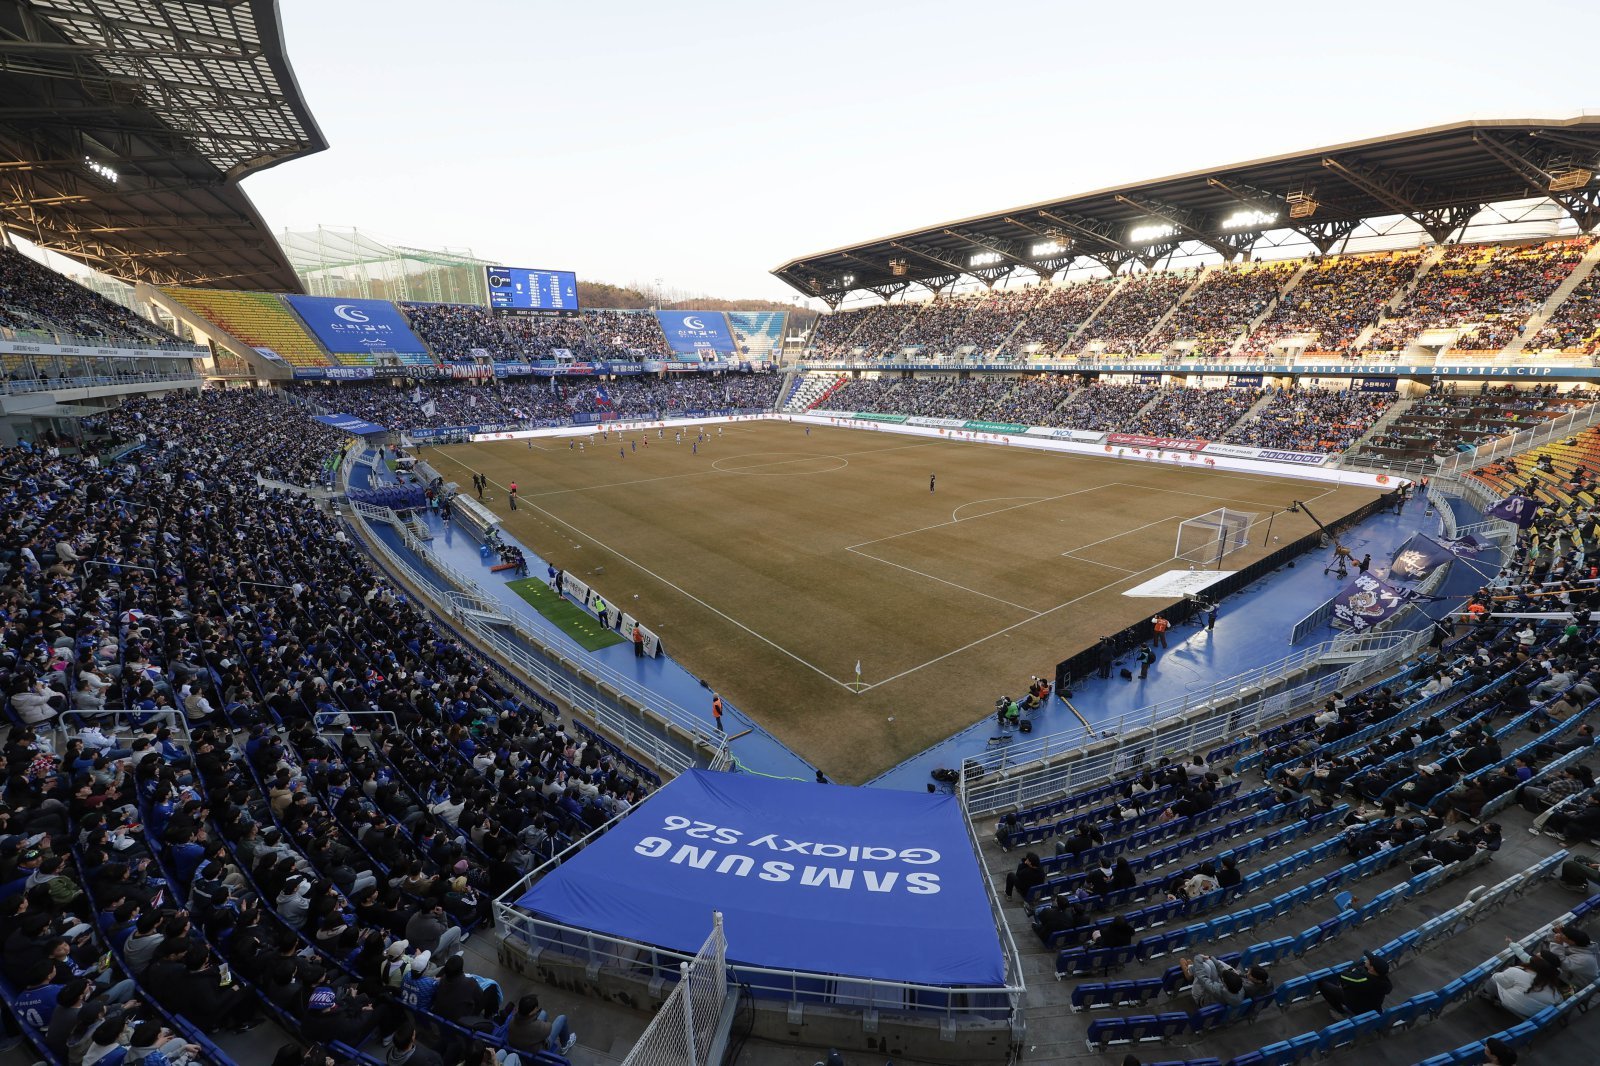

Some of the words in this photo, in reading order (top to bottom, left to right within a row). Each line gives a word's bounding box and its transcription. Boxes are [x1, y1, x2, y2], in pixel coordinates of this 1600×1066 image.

[452, 364, 492, 378] ROMANTICO
[1517, 368, 1552, 376] CUP
[1258, 450, 1324, 464] MEGABOX
[663, 814, 743, 845] S26
[747, 833, 941, 865] Galaxy
[634, 835, 941, 896] SAMSUNG
